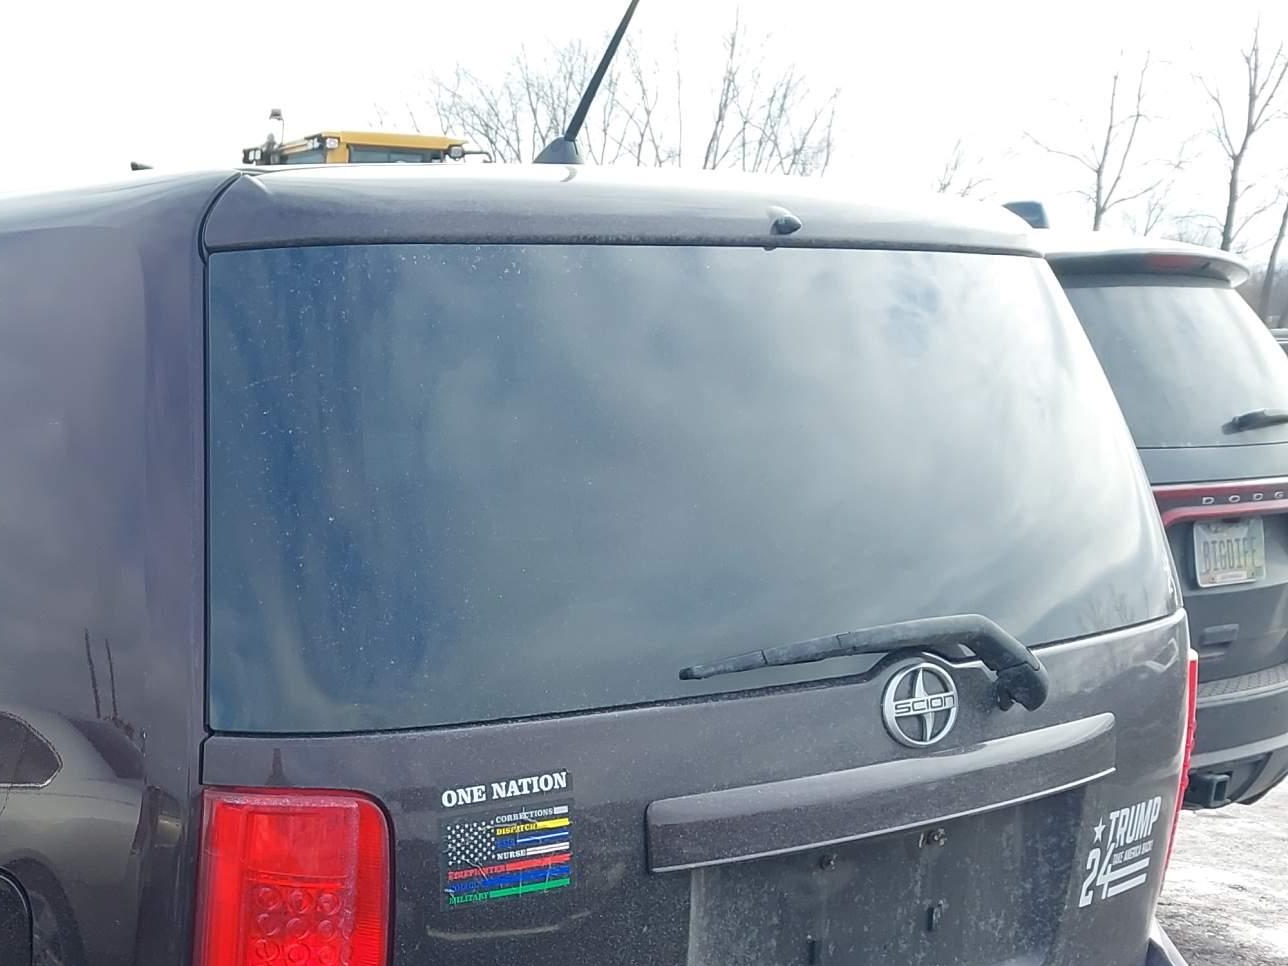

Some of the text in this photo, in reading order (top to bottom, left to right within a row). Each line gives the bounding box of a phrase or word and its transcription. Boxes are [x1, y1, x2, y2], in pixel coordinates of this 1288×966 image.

[895, 695, 956, 715] SCION
[441, 771, 567, 808] ONE NATION
[495, 808, 553, 823] CORRECTIONS
[1106, 796, 1162, 850] TRUMP
[496, 823, 537, 836] DISPATCH
[497, 850, 526, 860] NURSE
[1078, 842, 1116, 908] 24
[449, 891, 489, 904] MILITARY
